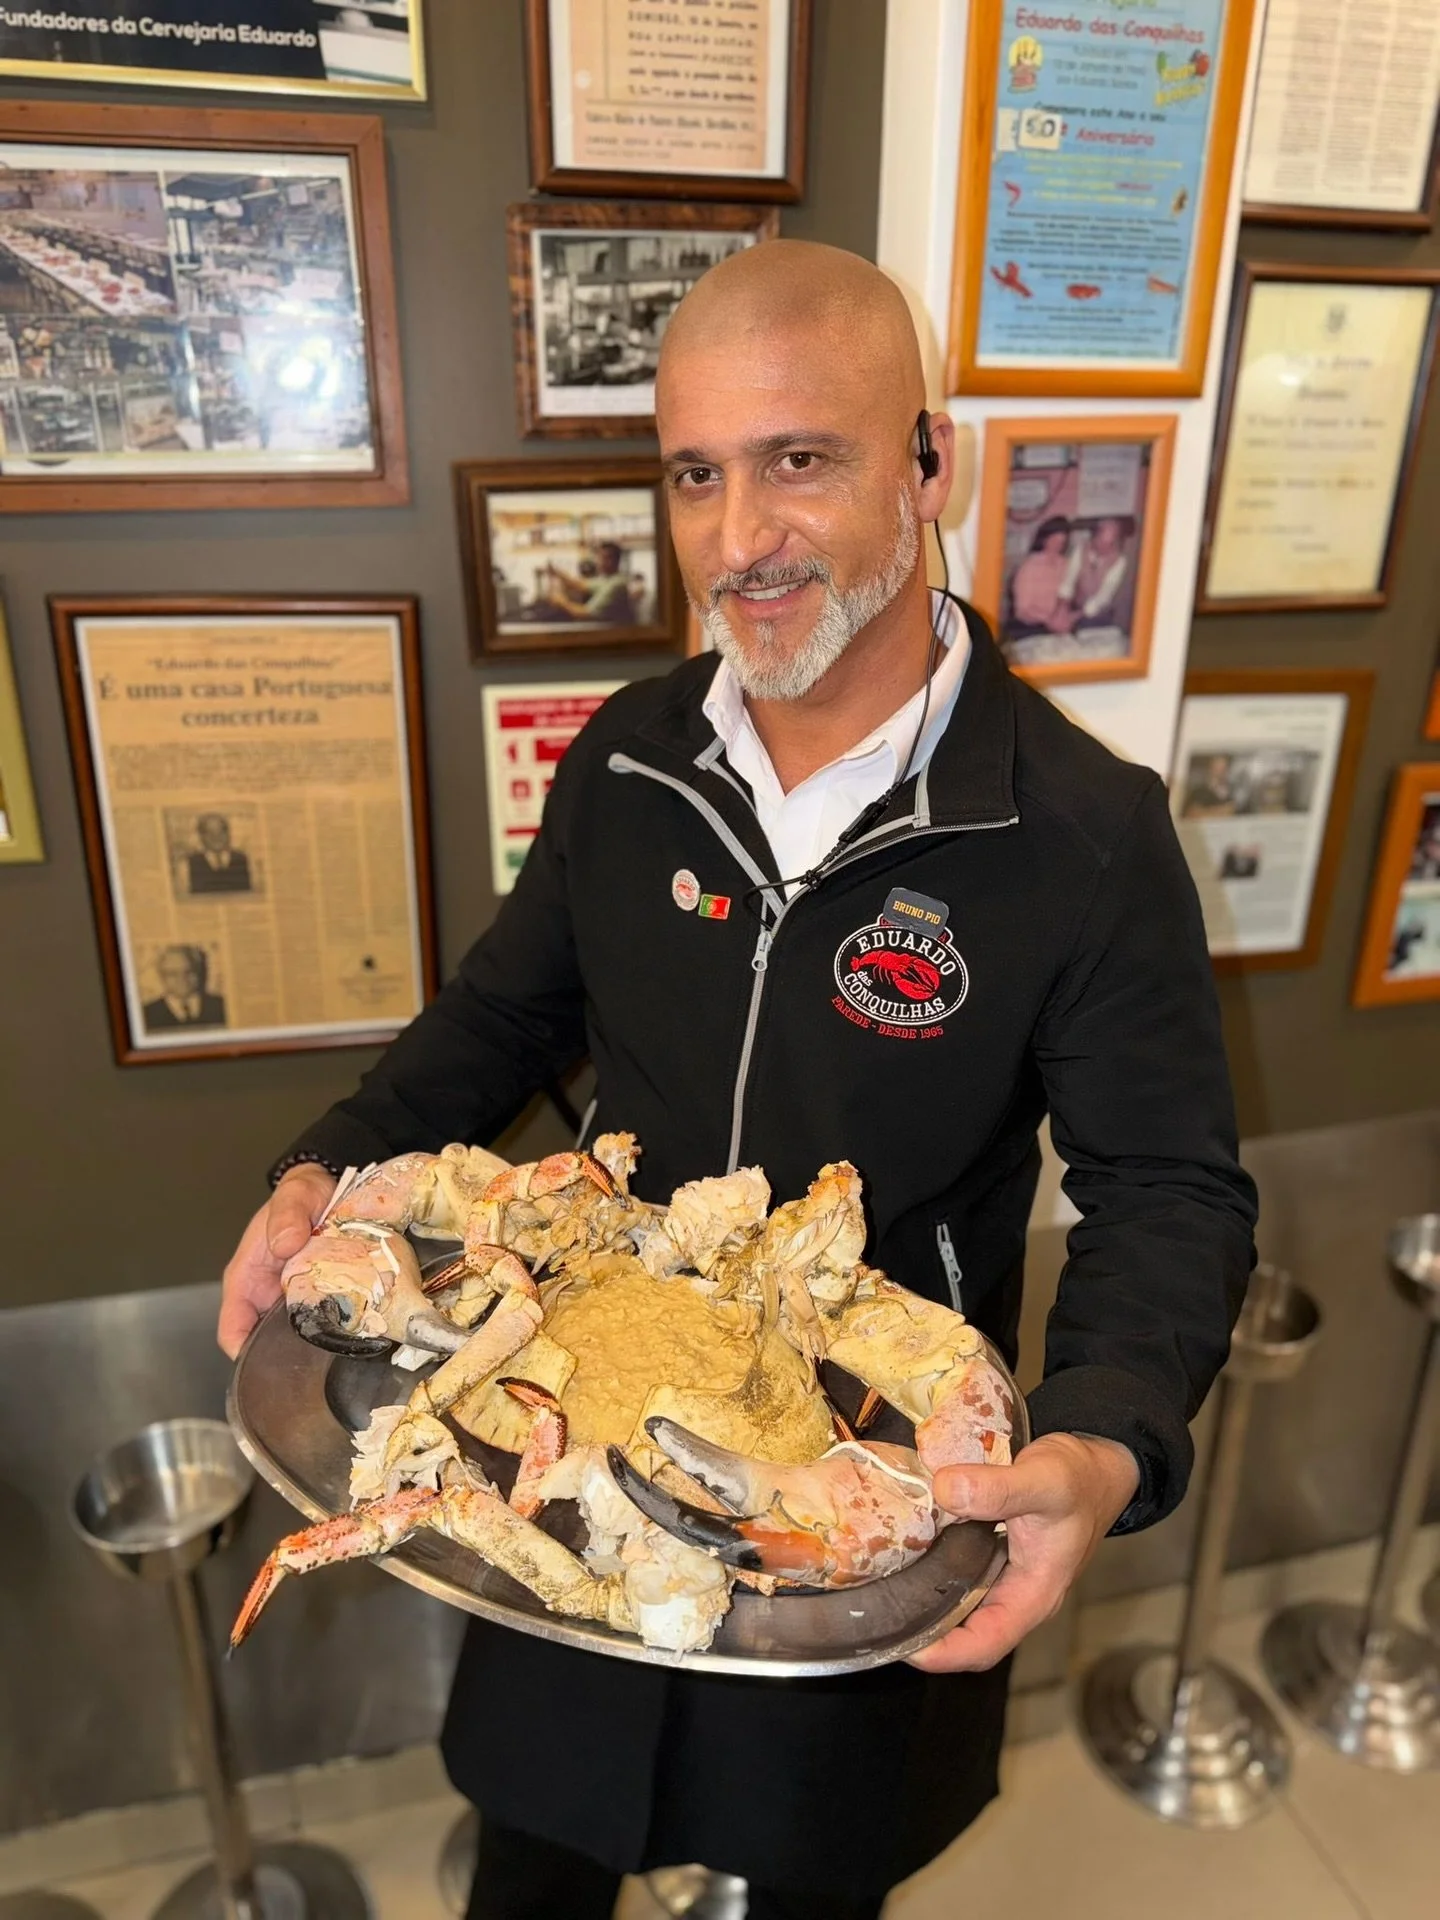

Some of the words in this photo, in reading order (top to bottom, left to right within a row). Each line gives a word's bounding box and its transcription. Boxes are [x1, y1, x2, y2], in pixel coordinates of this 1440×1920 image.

[111, 16, 137, 35] da
[139, 18, 236, 45] Cervejaria
[239, 25, 316, 47] Eduardo
[1015, 7, 1082, 32] Eduardo
[1089, 17, 1117, 35] das
[1123, 20, 1205, 45] Conquilhas
[126, 681, 183, 700] uma
[190, 681, 245, 699] casa
[253, 676, 392, 701] Portuguesa
[181, 706, 319, 729] concerteza
[892, 900, 924, 919] BRUNO
[924, 910, 941, 925] PIO
[856, 930, 956, 976] EDUARDO
[857, 970, 873, 987] das
[844, 972, 946, 1018] CONQUILHAS
[831, 995, 871, 1029] PAREDE
[877, 1024, 917, 1039] DESDE
[920, 1025, 944, 1040] 1965
